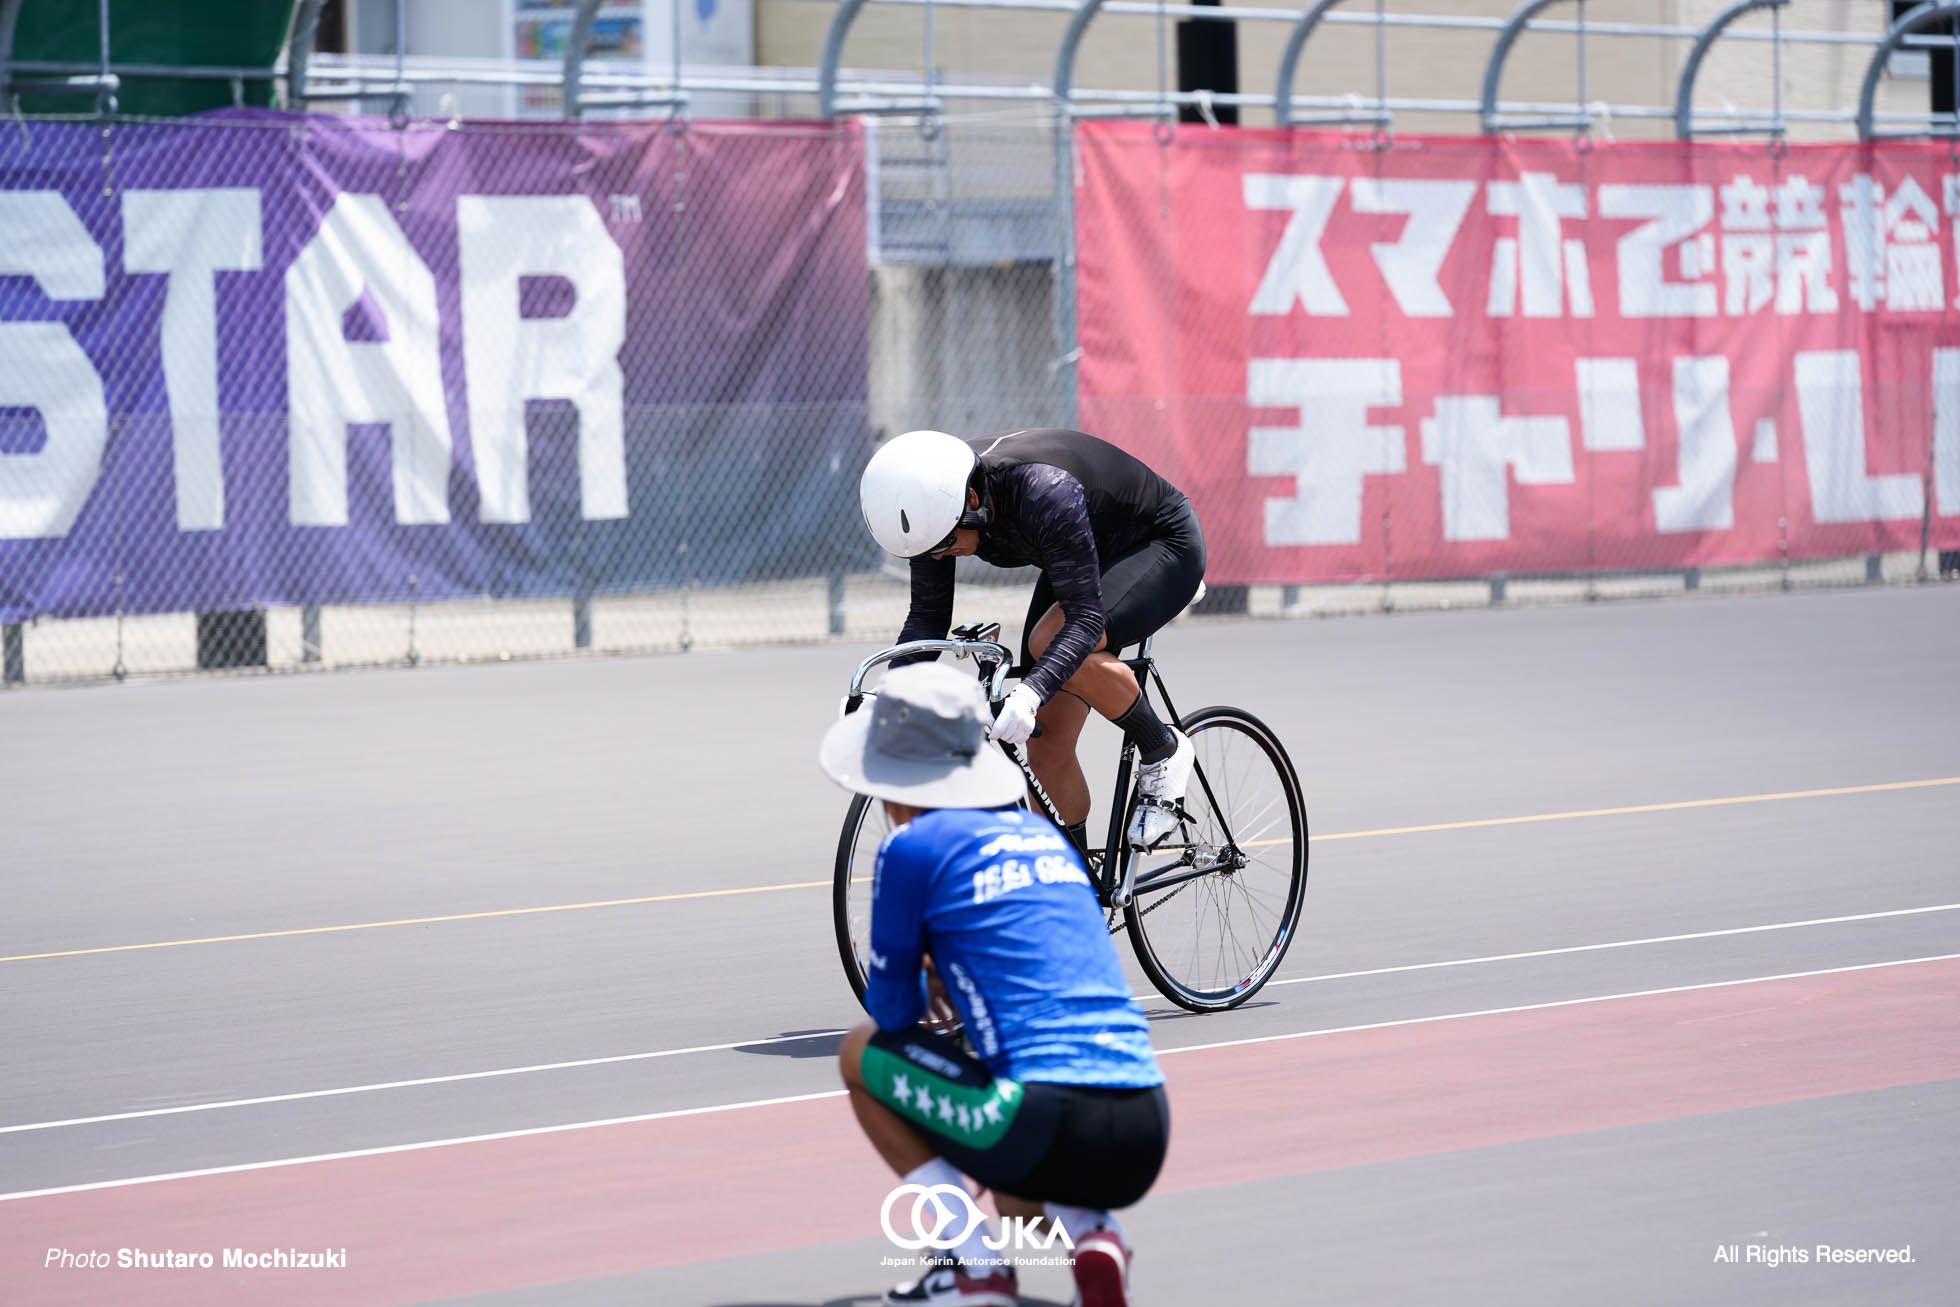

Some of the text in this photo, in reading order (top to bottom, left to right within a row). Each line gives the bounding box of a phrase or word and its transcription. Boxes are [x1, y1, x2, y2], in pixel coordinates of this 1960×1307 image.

[1242, 172, 1960, 318] スマホで競輪
